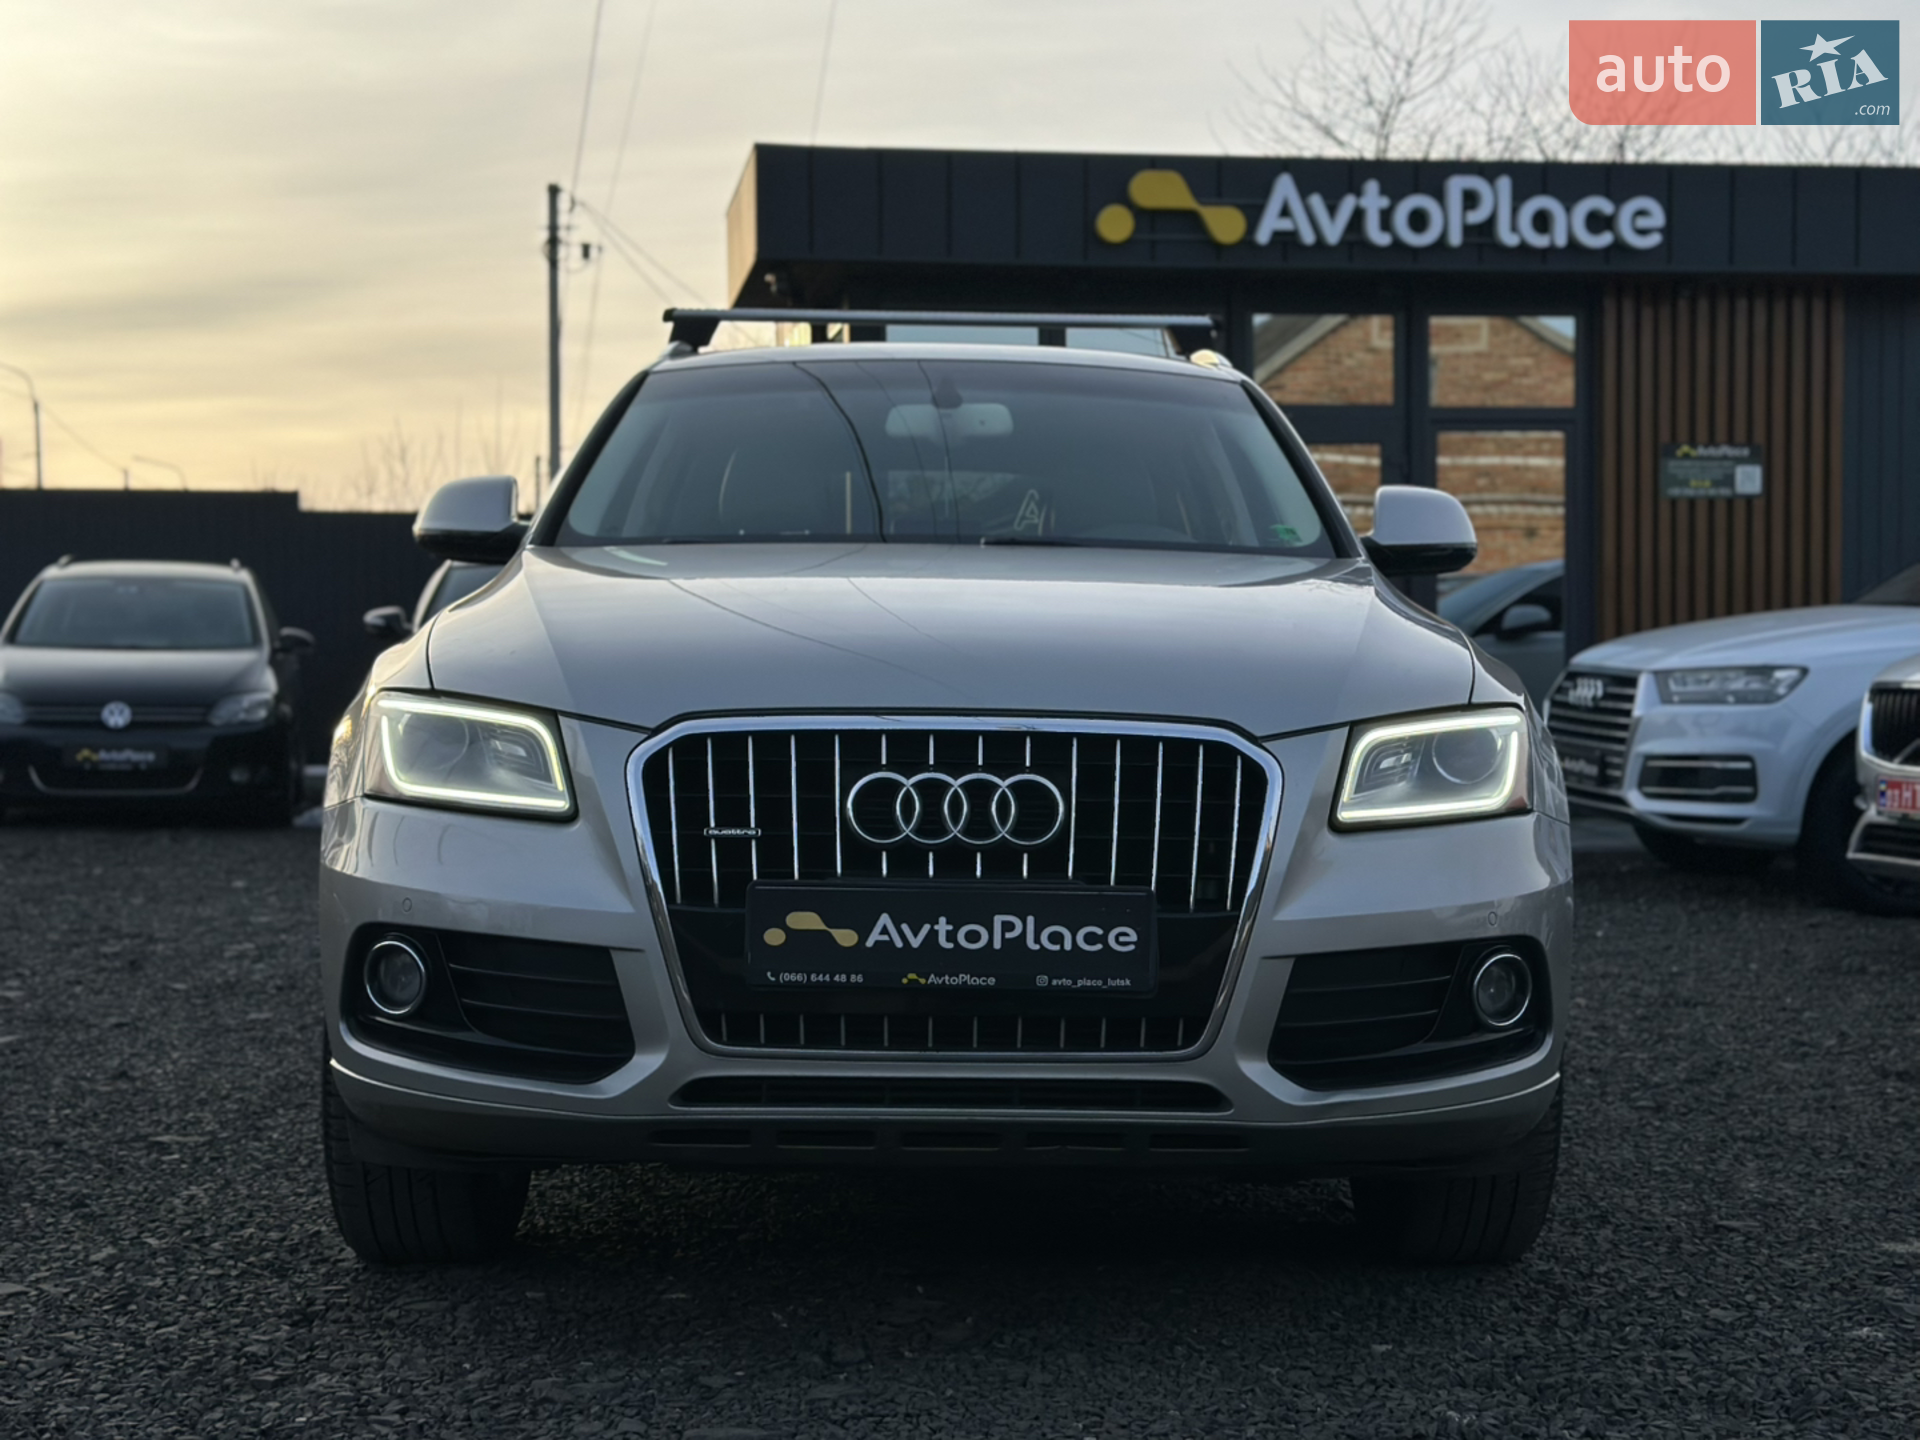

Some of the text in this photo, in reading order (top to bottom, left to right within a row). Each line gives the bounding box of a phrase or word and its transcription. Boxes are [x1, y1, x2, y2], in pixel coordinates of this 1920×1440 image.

[1254, 172, 1667, 250] AvtoPlace
[864, 912, 1139, 953] AvtoPlace
[779, 972, 864, 984] (066) 644 48 86
[927, 973, 996, 986] AvtoPlace
